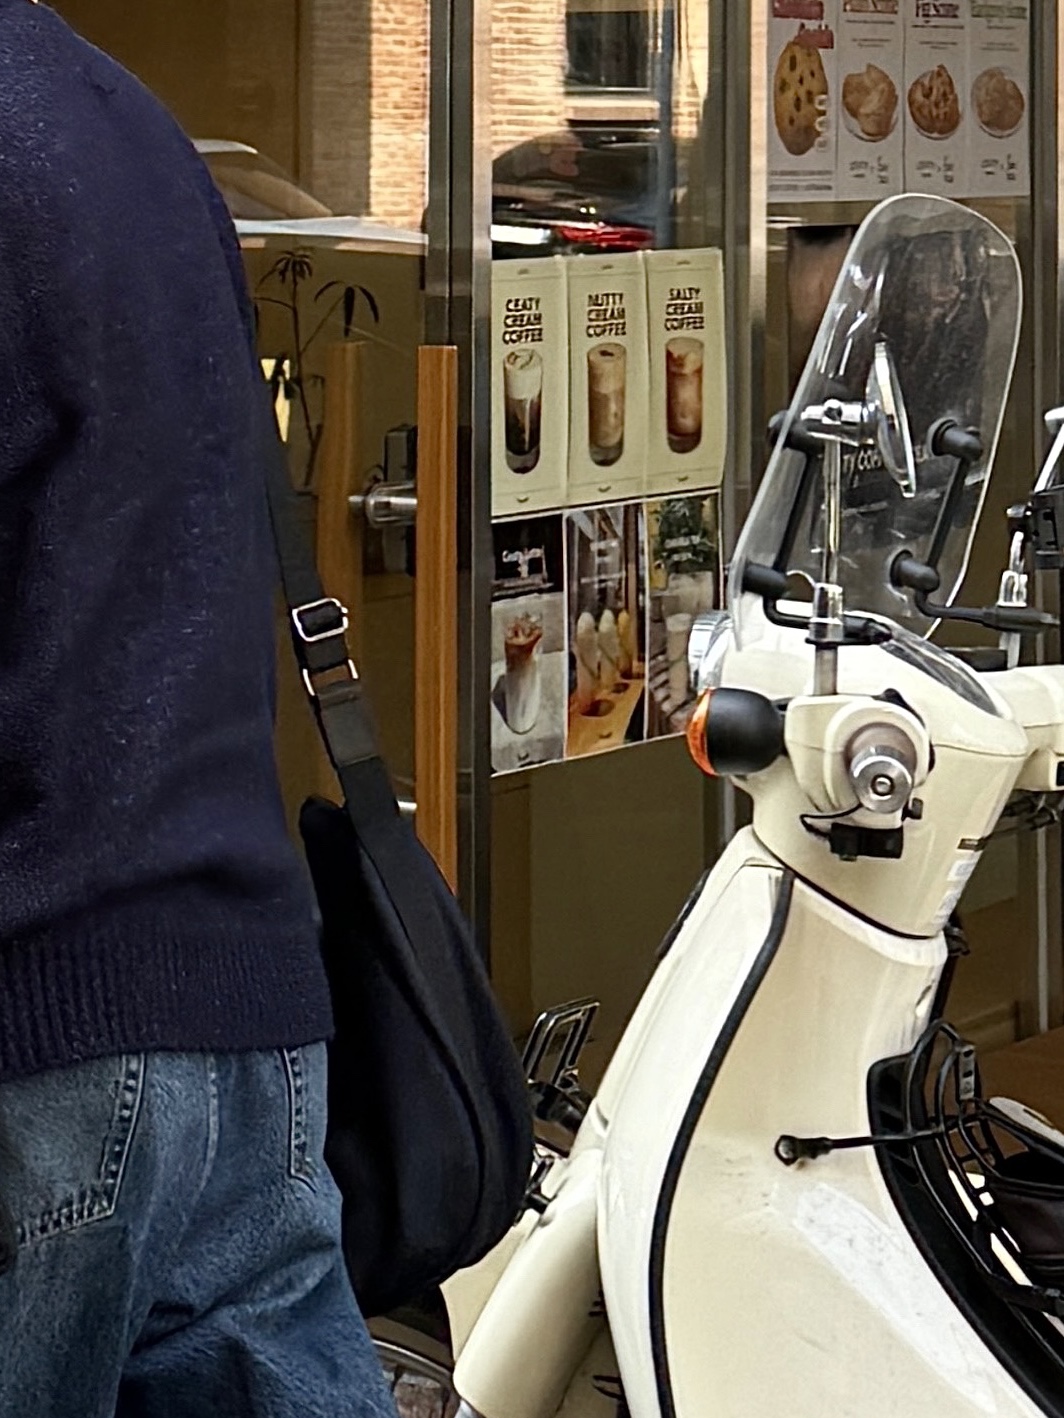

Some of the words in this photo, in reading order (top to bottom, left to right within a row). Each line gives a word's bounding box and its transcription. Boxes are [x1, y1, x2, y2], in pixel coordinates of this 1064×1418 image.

[588, 292, 623, 306] NUTTY
[669, 287, 700, 300] SALTY
[587, 307, 625, 322] CREAM
[666, 301, 703, 316] CREAM
[504, 313, 542, 328] CREAM
[664, 316, 704, 331] COFFEE
[502, 327, 543, 345] COFFEE
[586, 321, 626, 338] COFFEE
